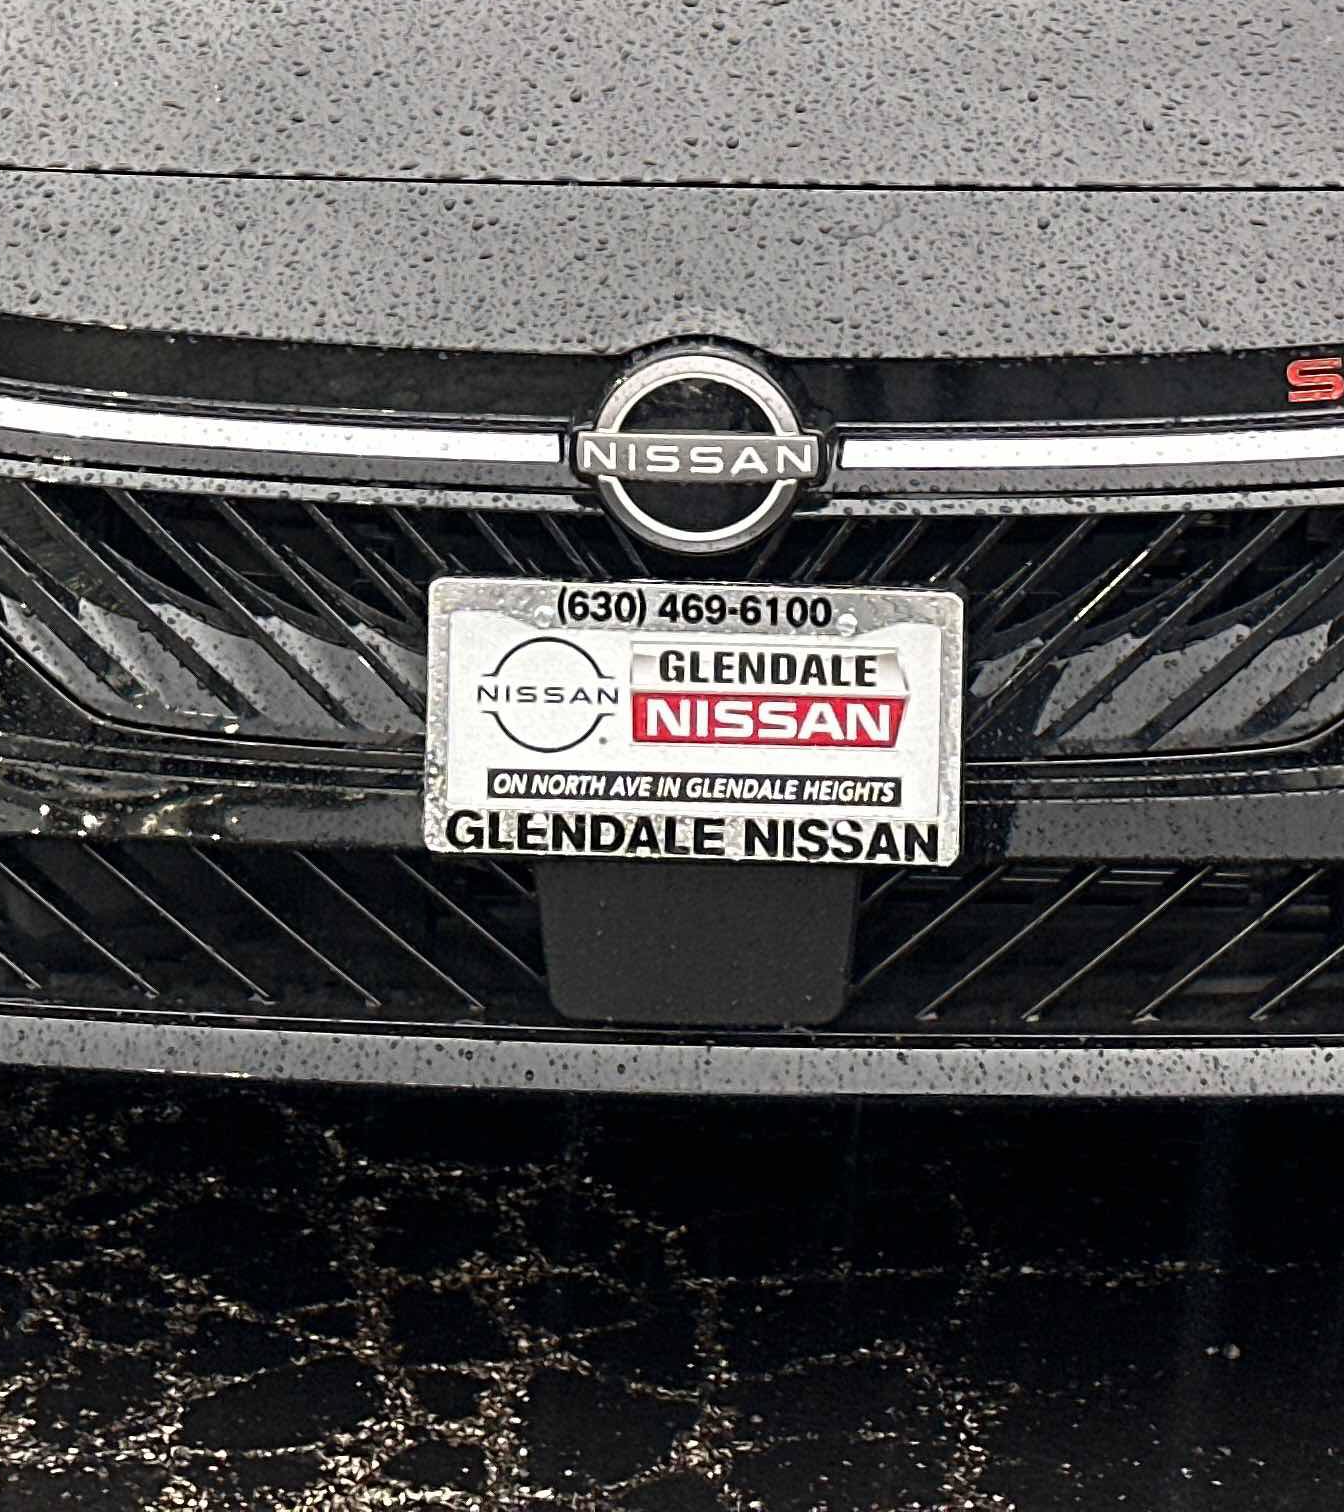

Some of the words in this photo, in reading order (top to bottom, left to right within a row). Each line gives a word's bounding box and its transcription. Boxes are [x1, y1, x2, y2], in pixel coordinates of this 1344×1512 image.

[583, 440, 812, 476] NISSAN
[558, 586, 646, 627] (630)
[658, 593, 831, 627] 469-6100
[659, 650, 877, 687] GLENDALE
[477, 685, 619, 705] NISSAN
[646, 698, 890, 741] NISSAN
[493, 773, 528, 795] ON
[531, 775, 606, 797] NORTH
[609, 776, 653, 798] AVE
[656, 777, 681, 799] IN
[686, 777, 799, 801] GLENDALE
[803, 780, 896, 804] HEIGHTS
[445, 809, 726, 858] GLENDALE
[743, 819, 939, 863] NISSAN
